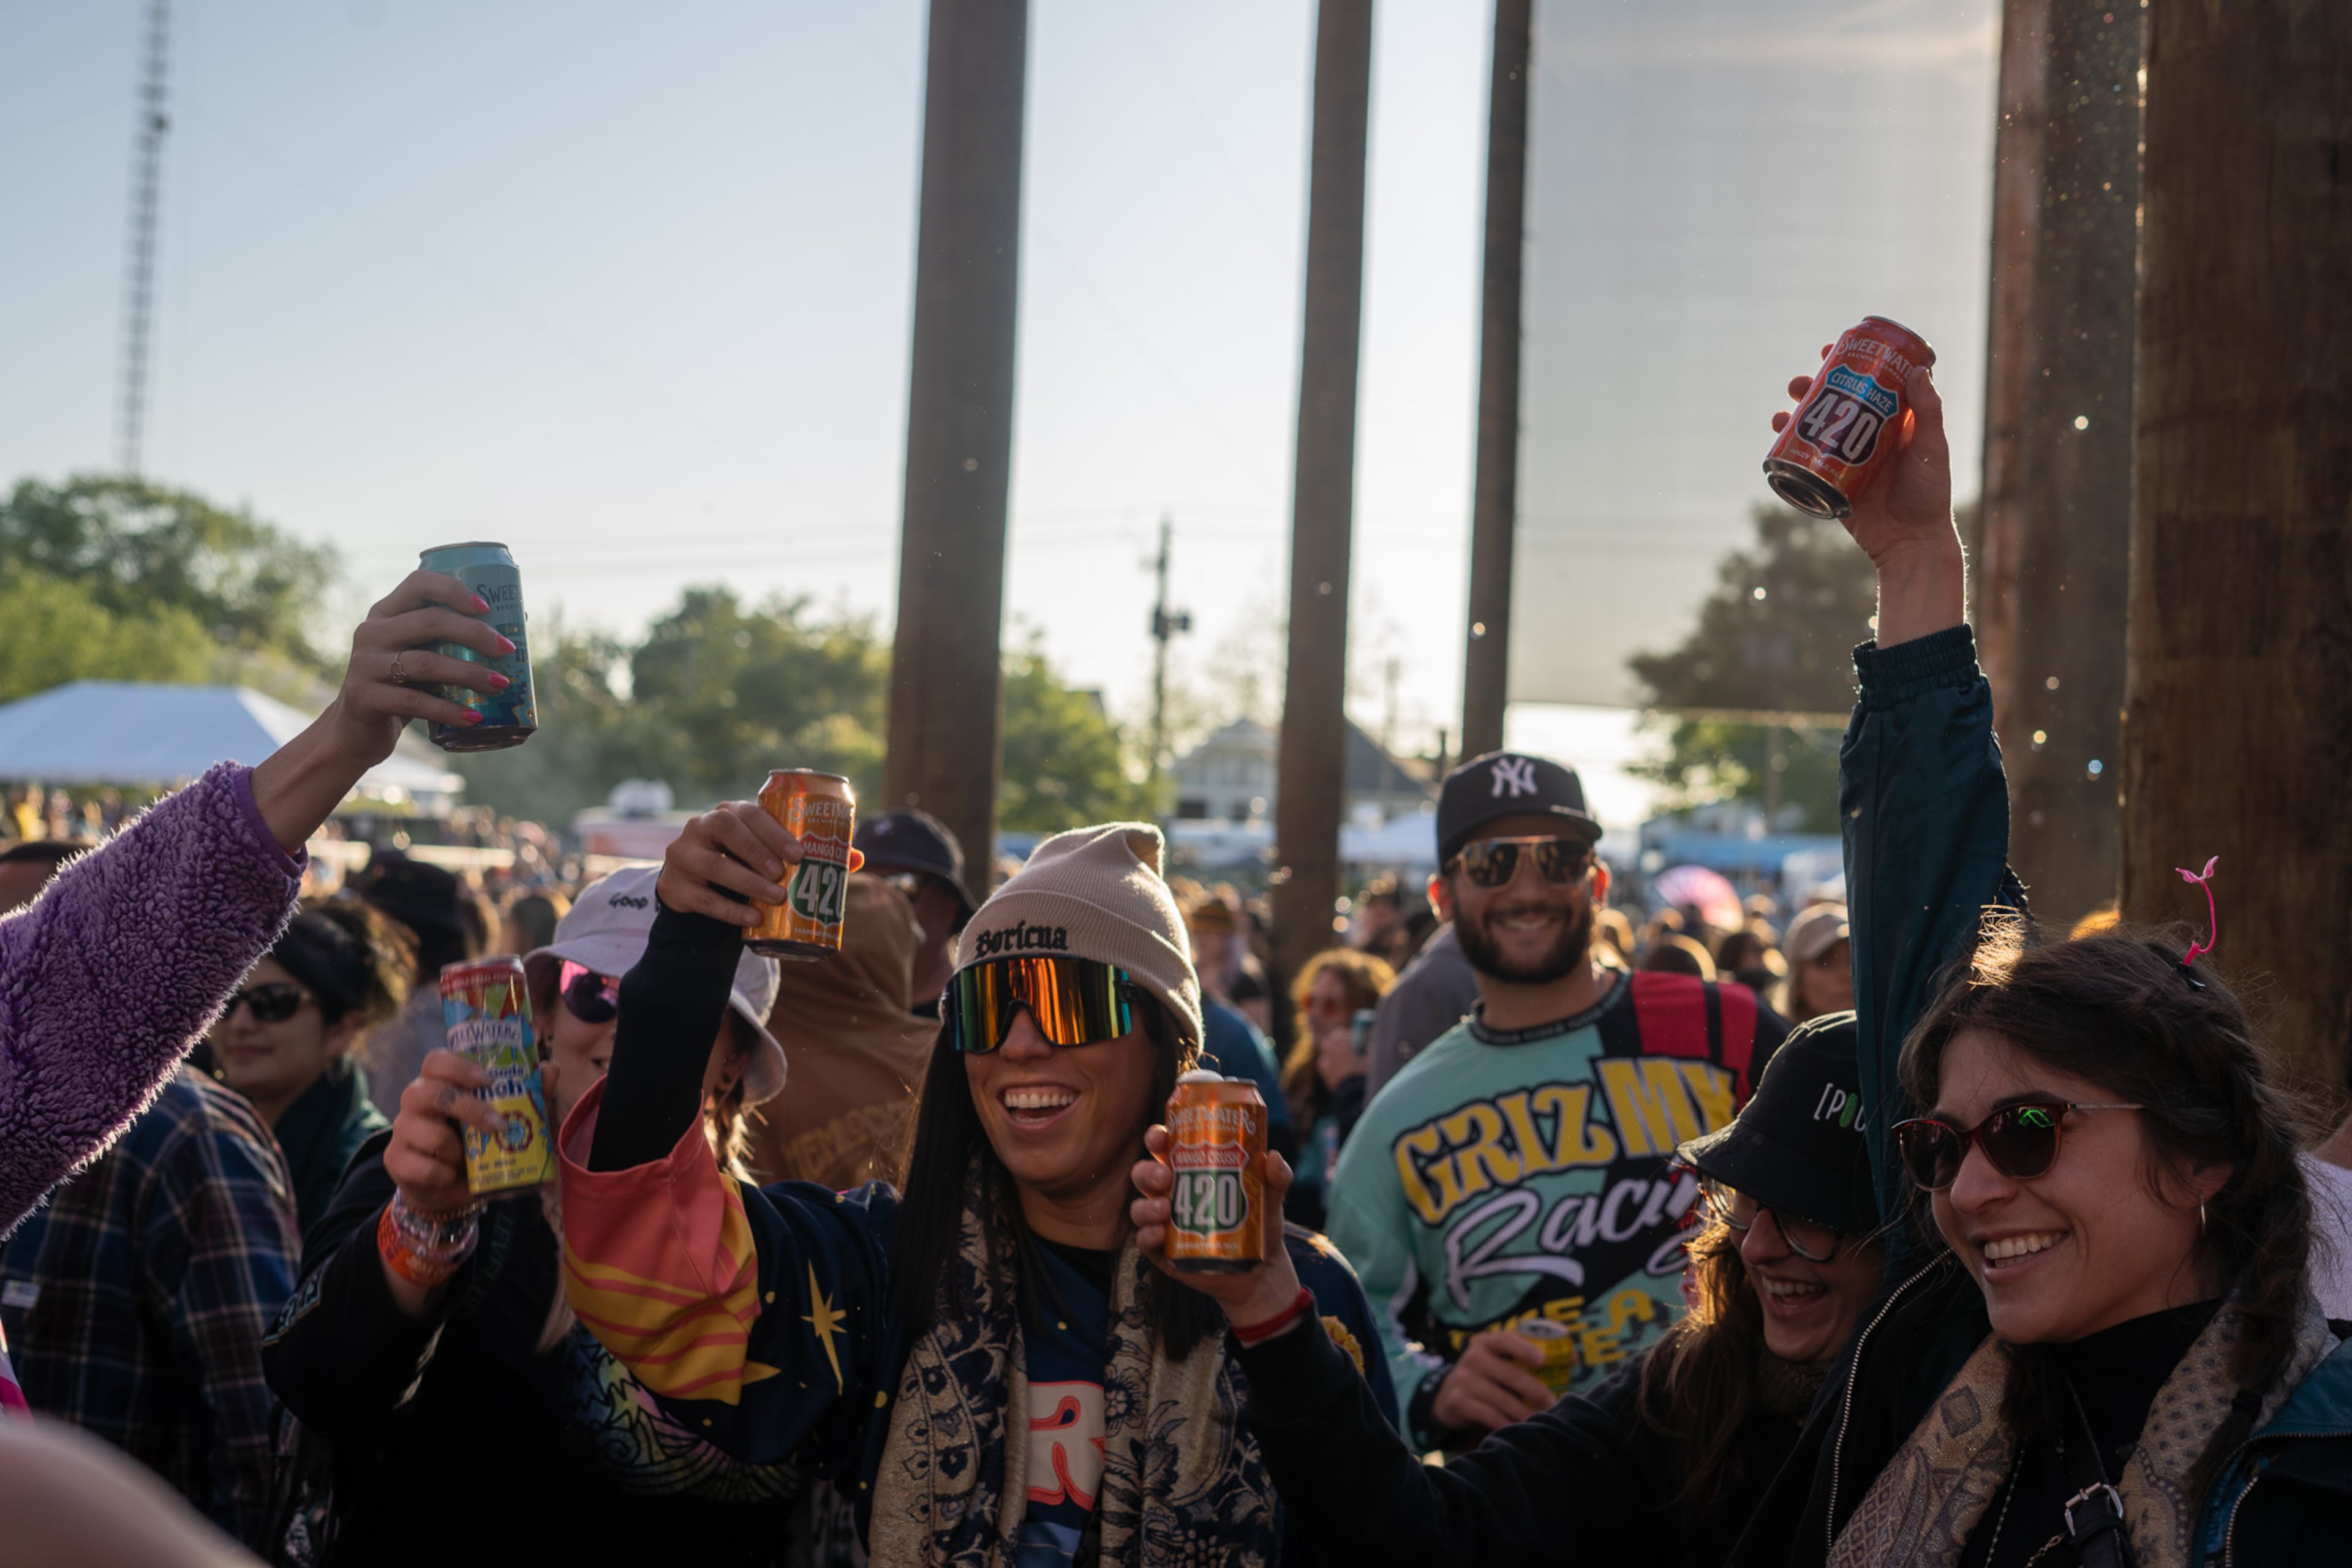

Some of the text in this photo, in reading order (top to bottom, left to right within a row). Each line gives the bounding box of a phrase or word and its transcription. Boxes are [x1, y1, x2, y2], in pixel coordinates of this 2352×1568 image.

[1836, 334, 1912, 379] SWEETWATE
[1831, 372, 1893, 412] CITRUS HAZE
[1804, 393, 1877, 459] 420
[1491, 757, 1538, 797] NY
[788, 798, 850, 821] SWEETWA
[803, 841, 835, 858] MANGO
[1167, 1106, 1256, 1135] SWEETWATER
[1175, 1150, 1206, 1164] MANGO
[1393, 1084, 1618, 1224] GRIZ
[1174, 1174, 1238, 1226] 420
